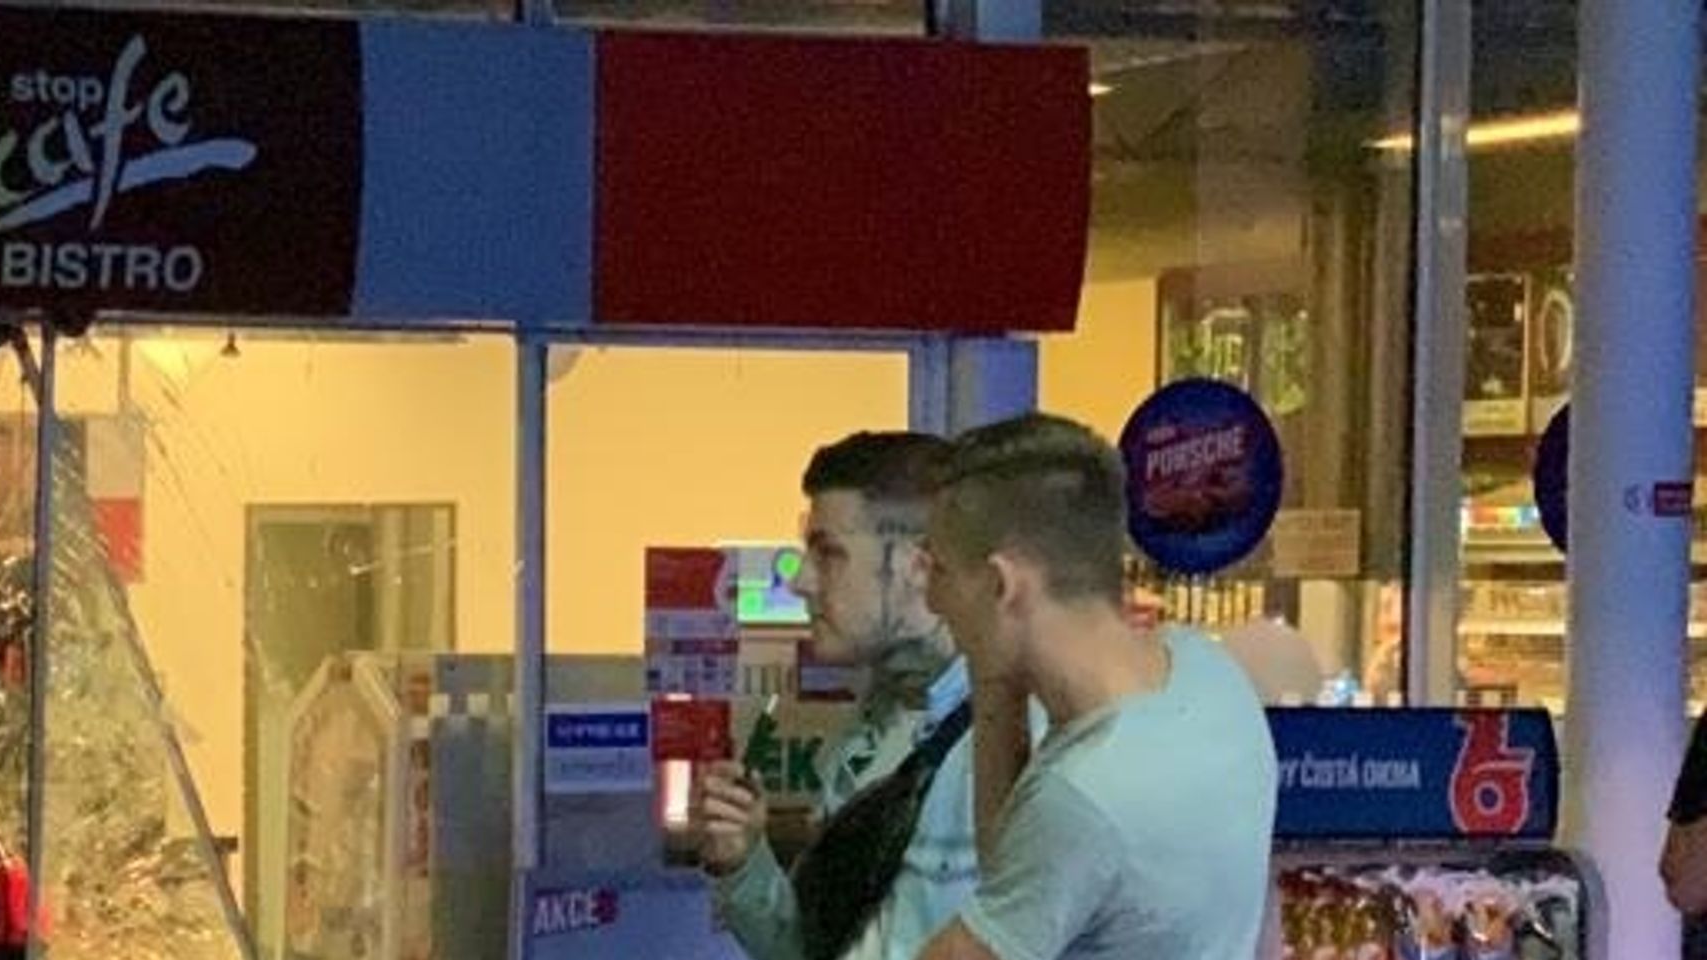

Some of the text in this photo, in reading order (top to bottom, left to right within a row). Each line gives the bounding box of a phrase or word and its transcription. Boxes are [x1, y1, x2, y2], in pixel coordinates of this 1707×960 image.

[11, 70, 103, 109] stop
[0, 242, 204, 292] BISTRO
[1146, 426, 1244, 482] PORSCHE
